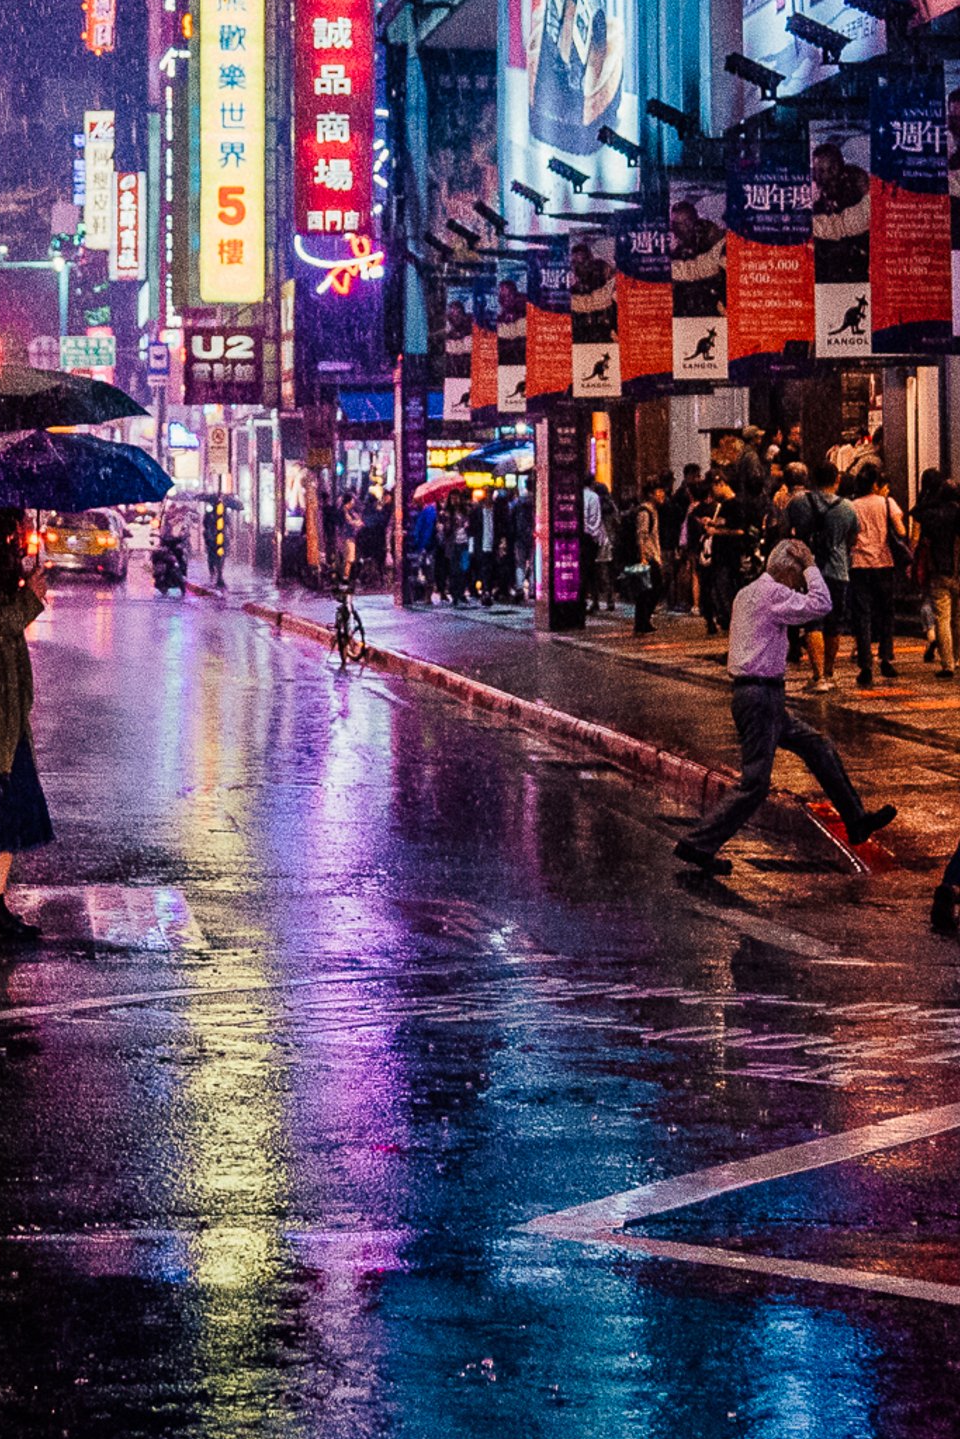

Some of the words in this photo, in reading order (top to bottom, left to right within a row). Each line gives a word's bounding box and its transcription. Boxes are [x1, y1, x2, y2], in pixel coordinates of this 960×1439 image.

[312, 17, 353, 191] 誠品商場
[307, 210, 360, 231] 西門店
[191, 335, 255, 360] U2
[827, 337, 869, 345] KANGOL
